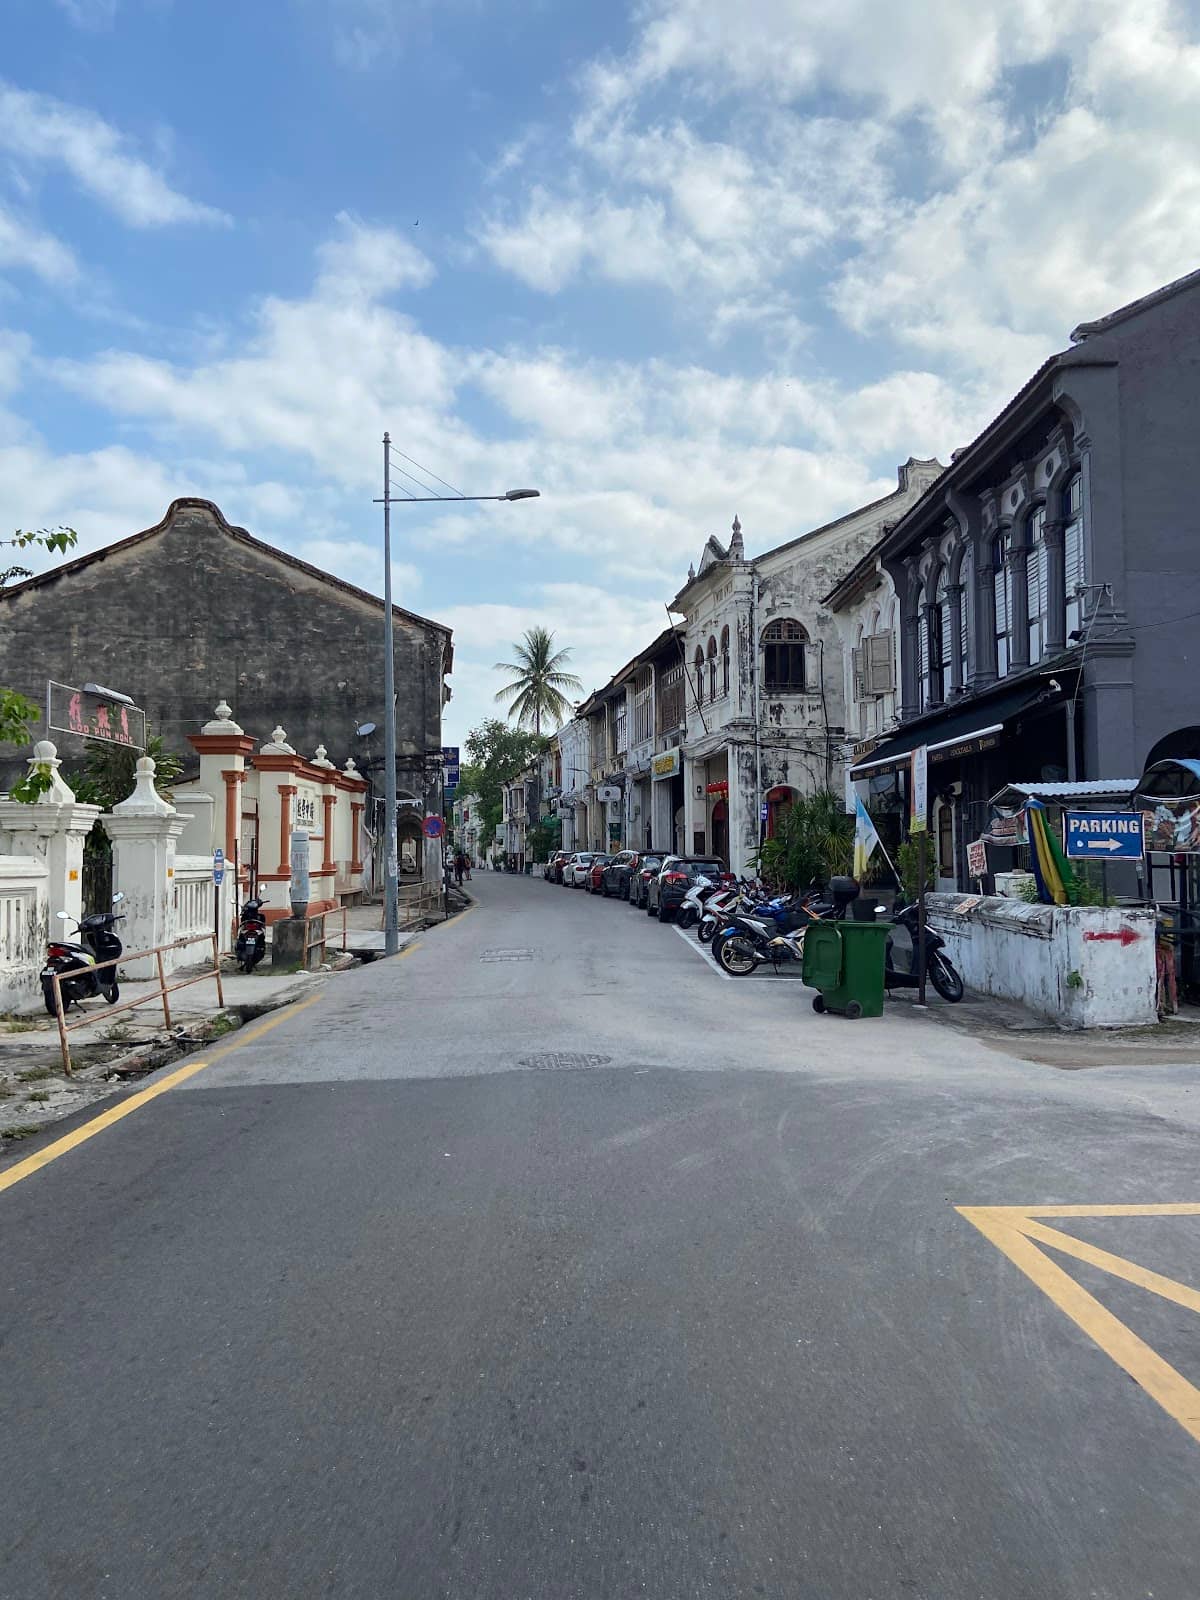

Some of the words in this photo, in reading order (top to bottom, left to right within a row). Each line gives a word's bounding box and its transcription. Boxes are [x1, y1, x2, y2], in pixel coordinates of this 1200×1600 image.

[69, 721, 90, 734] LOO
[94, 727, 112, 738] PUN
[1069, 819, 1140, 833] PARKING
